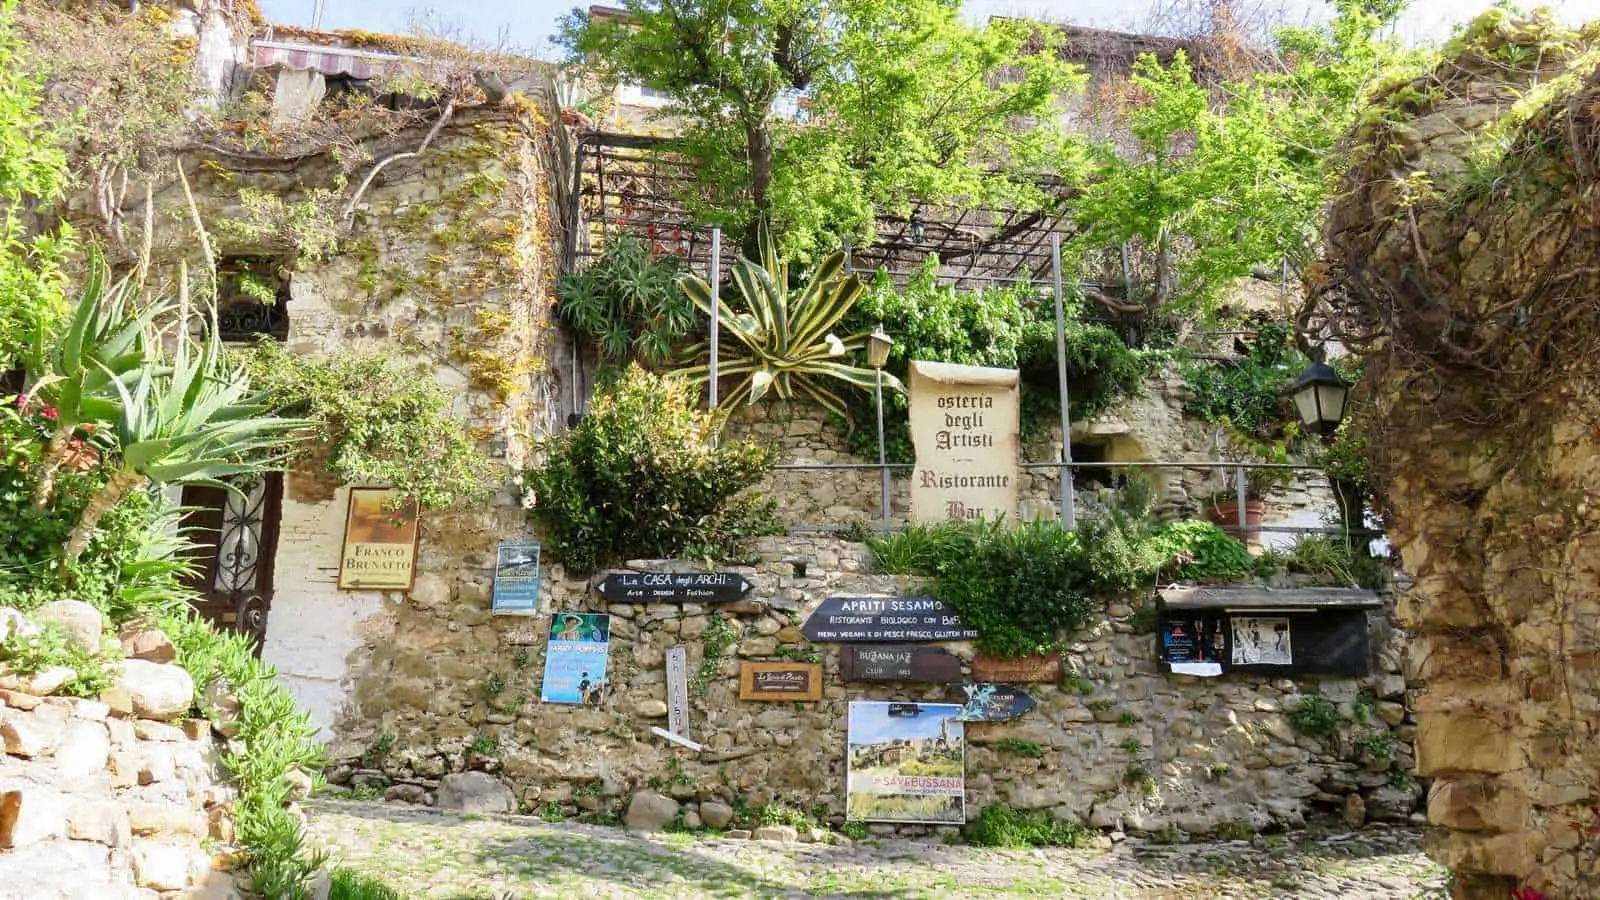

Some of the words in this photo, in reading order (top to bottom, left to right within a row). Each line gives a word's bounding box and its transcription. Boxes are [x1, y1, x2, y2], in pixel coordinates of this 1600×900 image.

[937, 394, 993, 409] osteria
[945, 412, 984, 430] degli
[936, 431, 993, 450] Artisti
[920, 470, 1009, 488] Ristorante
[945, 501, 984, 520] Bar
[355, 545, 405, 557] FRANCO
[346, 559, 411, 569] BRUNATTO
[623, 575, 638, 585] La
[643, 575, 672, 585] CASA
[676, 576, 693, 587] degli
[695, 574, 726, 585] ARCHI
[842, 601, 886, 611] APRITI
[891, 601, 943, 611] SESAMO
[829, 616, 873, 625] RISTORANTE
[880, 616, 918, 625] BIOLOGICO
